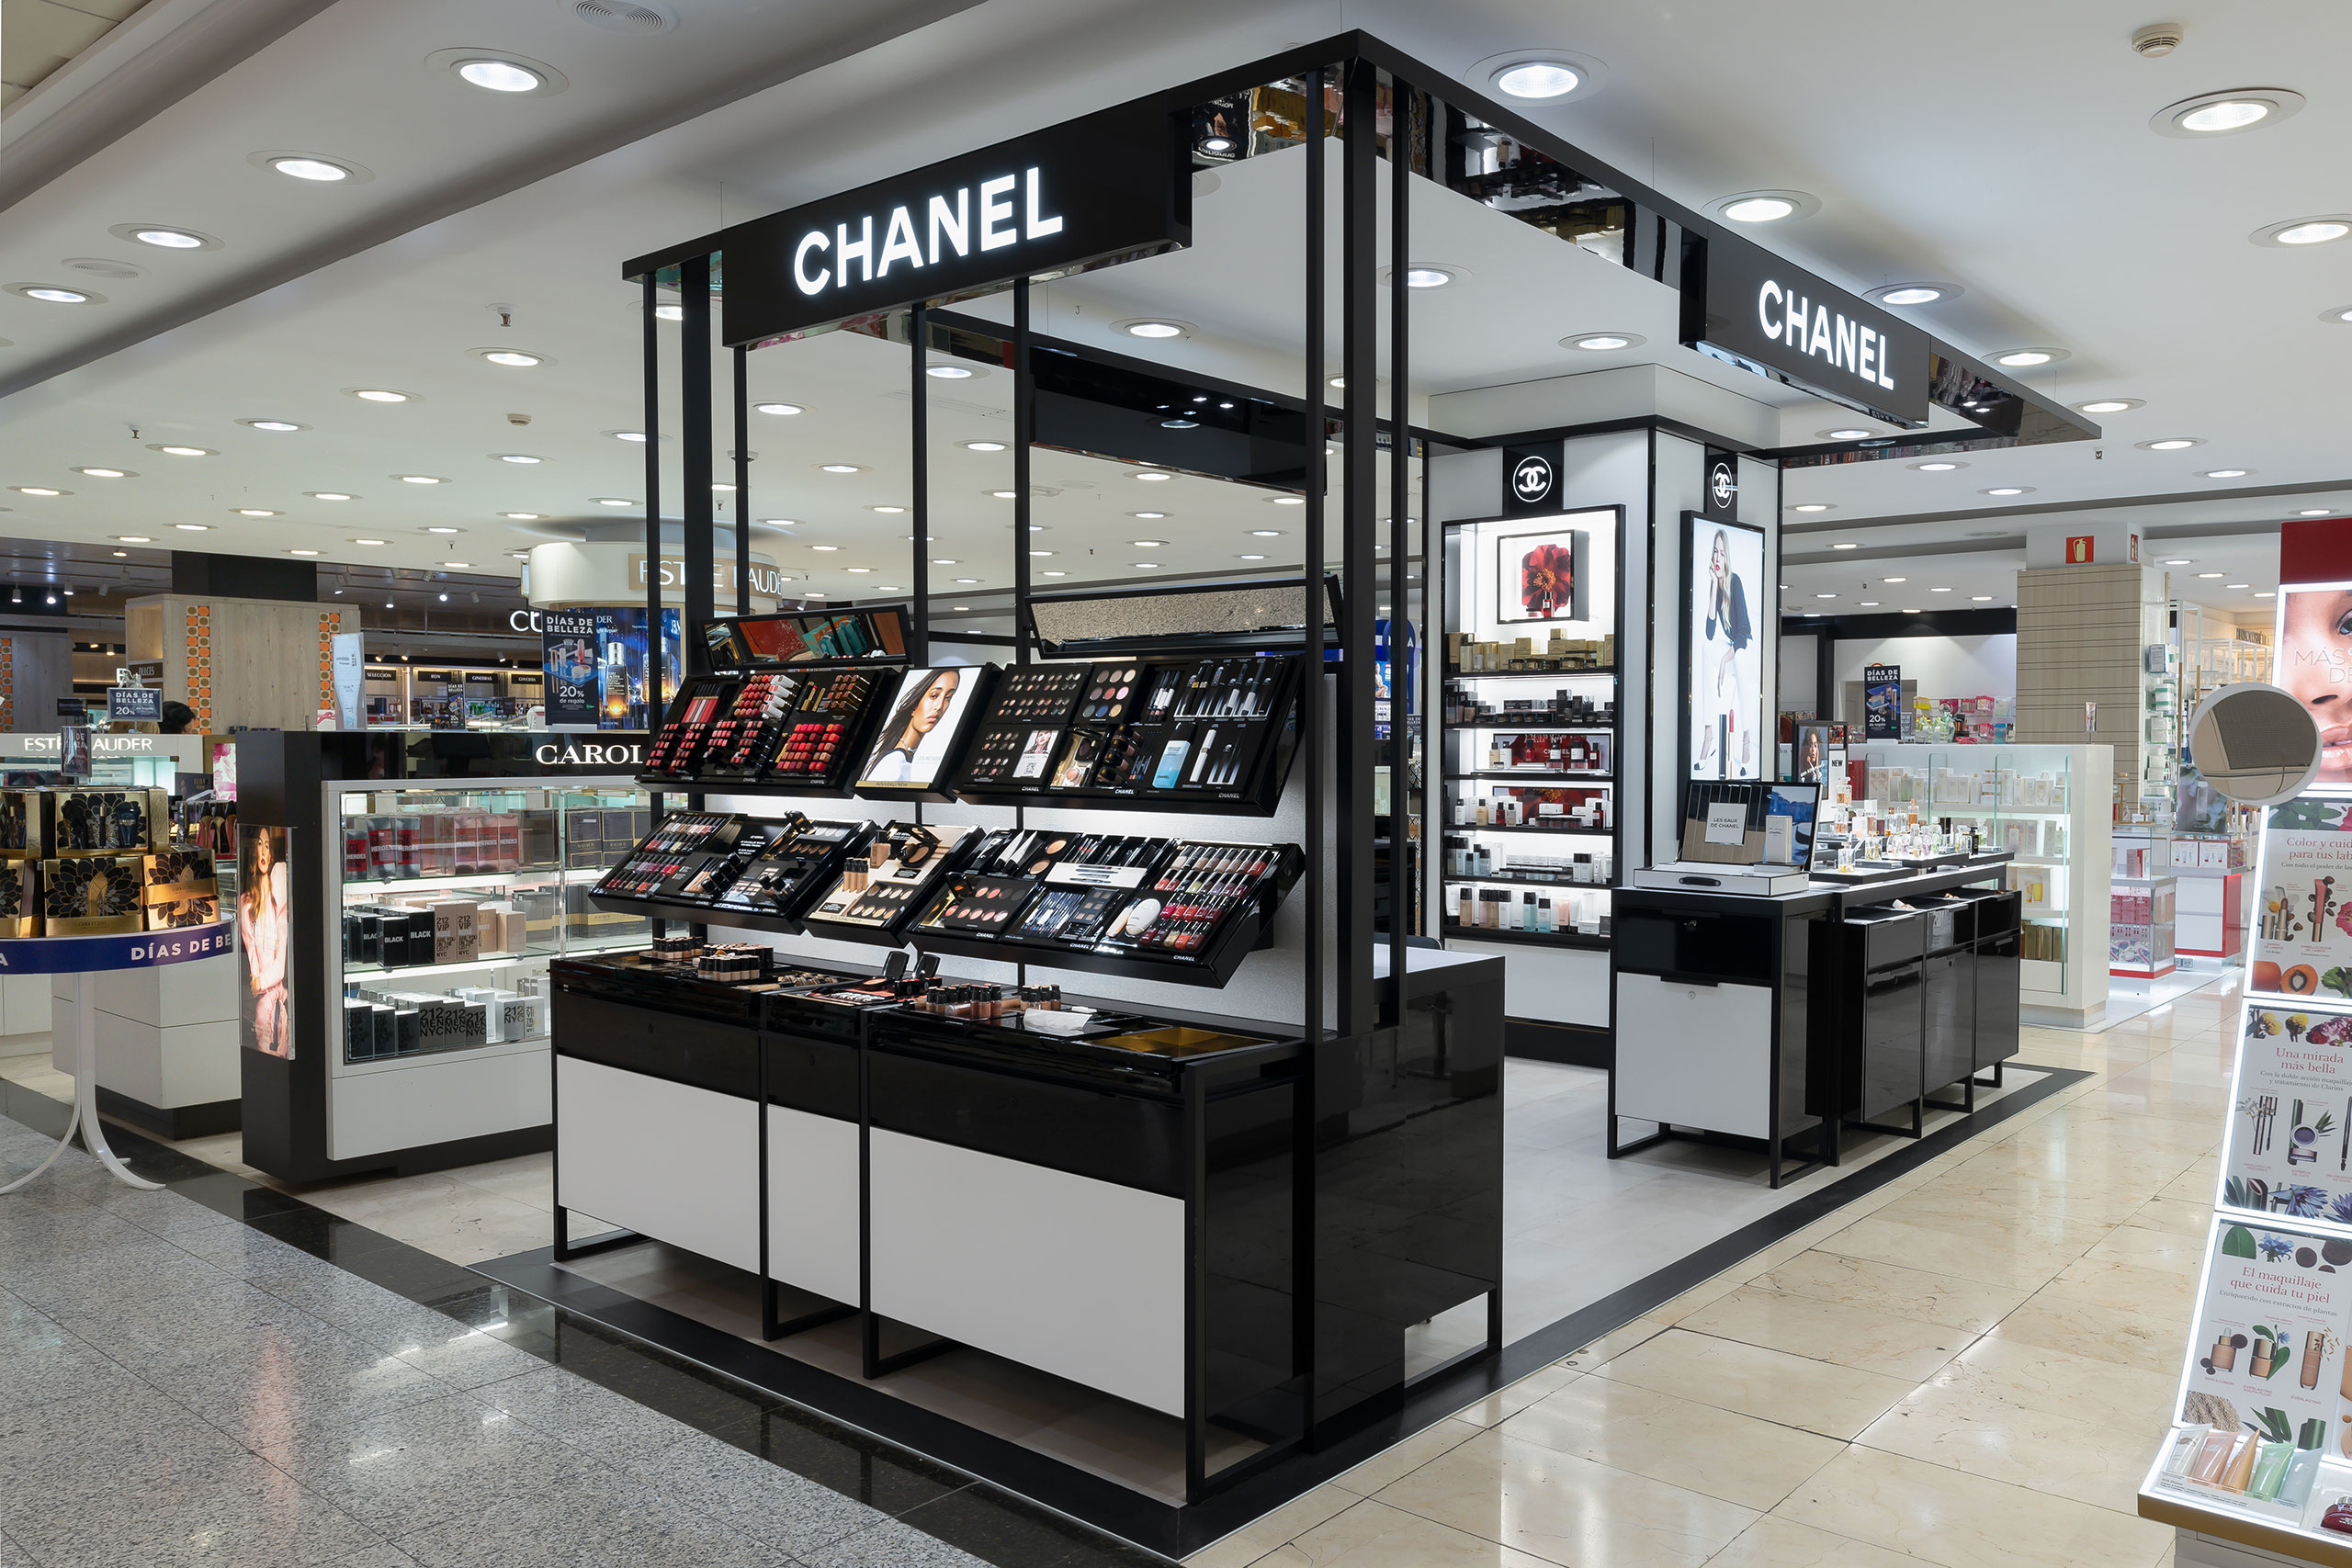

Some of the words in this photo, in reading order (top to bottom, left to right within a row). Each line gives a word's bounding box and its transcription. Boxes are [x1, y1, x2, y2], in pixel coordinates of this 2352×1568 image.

[794, 166, 1063, 296] CHANEL
[1758, 279, 1894, 390] CHANEL
[547, 615, 574, 626] DÍAS
[578, 618, 594, 626] DE
[596, 615, 613, 624] DER
[547, 625, 594, 634] BELLEZA
[2294, 647, 2346, 666] MÁS
[560, 685, 584, 698] 20%
[116, 705, 136, 716] 20%
[1869, 715, 1886, 723] 20%
[24, 736, 62, 751] EST
[92, 738, 153, 751] AUDER
[536, 744, 643, 764] CAROL
[2286, 837, 2318, 848] Color
[2319, 840, 2327, 851] y
[2289, 851, 2313, 861] para
[2316, 852, 2334, 860] tus
[2316, 863, 2335, 871] poder
[436, 917, 449, 925] 212
[458, 915, 471, 923] 212
[436, 923, 450, 931] VIP
[384, 935, 404, 943] BLACK
[410, 930, 432, 939] BLACK
[130, 942, 182, 961] DÍAS
[189, 937, 210, 953] DE
[215, 933, 232, 949] BE
[420, 1007, 444, 1021] 212
[445, 1009, 466, 1020] 212
[467, 1011, 486, 1022] 212
[504, 1006, 525, 1017] 212
[420, 1019, 444, 1029] MEN
[445, 1019, 466, 1028] MEN
[504, 1014, 525, 1024] NYC
[445, 1026, 466, 1035] NYC
[467, 1021, 486, 1030] MEN
[420, 1027, 444, 1037] NYC
[467, 1028, 486, 1037] NYC
[2276, 1047, 2300, 1059] Una
[2302, 1051, 2344, 1064] mirada
[2280, 1060, 2304, 1071] más
[2308, 1061, 2336, 1074] bella
[2260, 1069, 2273, 1077] Con
[2281, 1072, 2300, 1080] doble
[2300, 1074, 2321, 1082] acción
[2274, 1078, 2311, 1088] tratamiento
[2321, 1084, 2344, 1092] Clarins
[2243, 1266, 2256, 1278] El
[2258, 1269, 2323, 1291] maquillaje
[2230, 1278, 2253, 1290] que
[2255, 1282, 2288, 1296] cuida
[2290, 1290, 2303, 1299] tu
[2306, 1292, 2330, 1303] piel
[2219, 1289, 2258, 1302] Enriquecido
[2258, 1296, 2272, 1304] con
[2272, 1300, 2302, 1311] extractos
[2303, 1304, 2312, 1313] de
[2312, 1306, 2337, 1316] plantas
